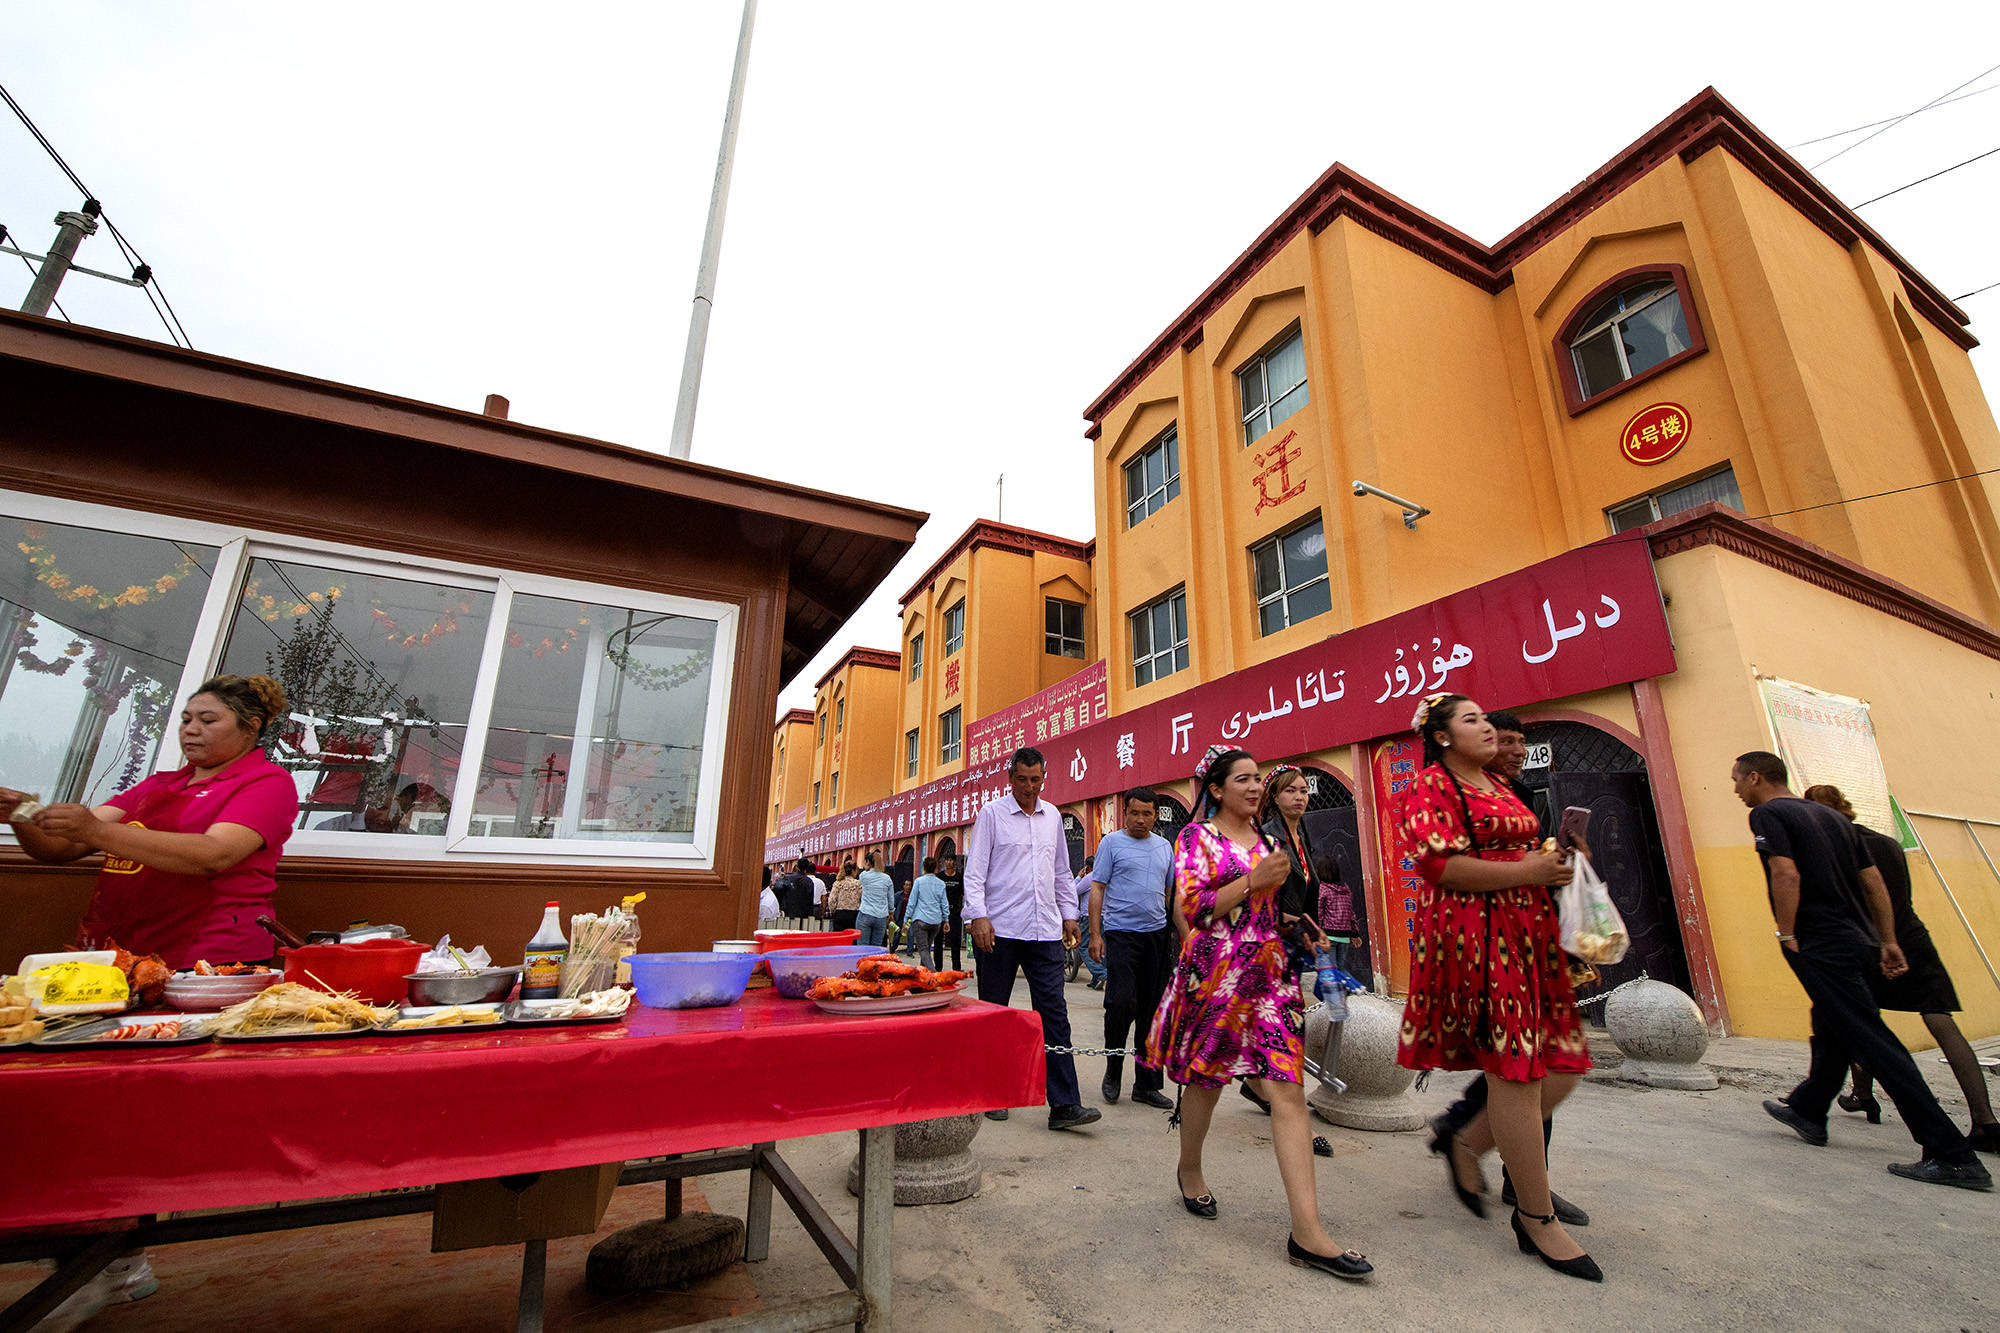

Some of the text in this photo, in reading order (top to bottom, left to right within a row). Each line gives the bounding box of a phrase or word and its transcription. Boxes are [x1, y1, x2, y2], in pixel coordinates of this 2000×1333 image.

[1630, 414, 1682, 450] 4号楼
[1251, 429, 1307, 517] 迁
[969, 728, 1026, 767] 脱贫先立志
[1036, 692, 1107, 742] 致富靠自己
